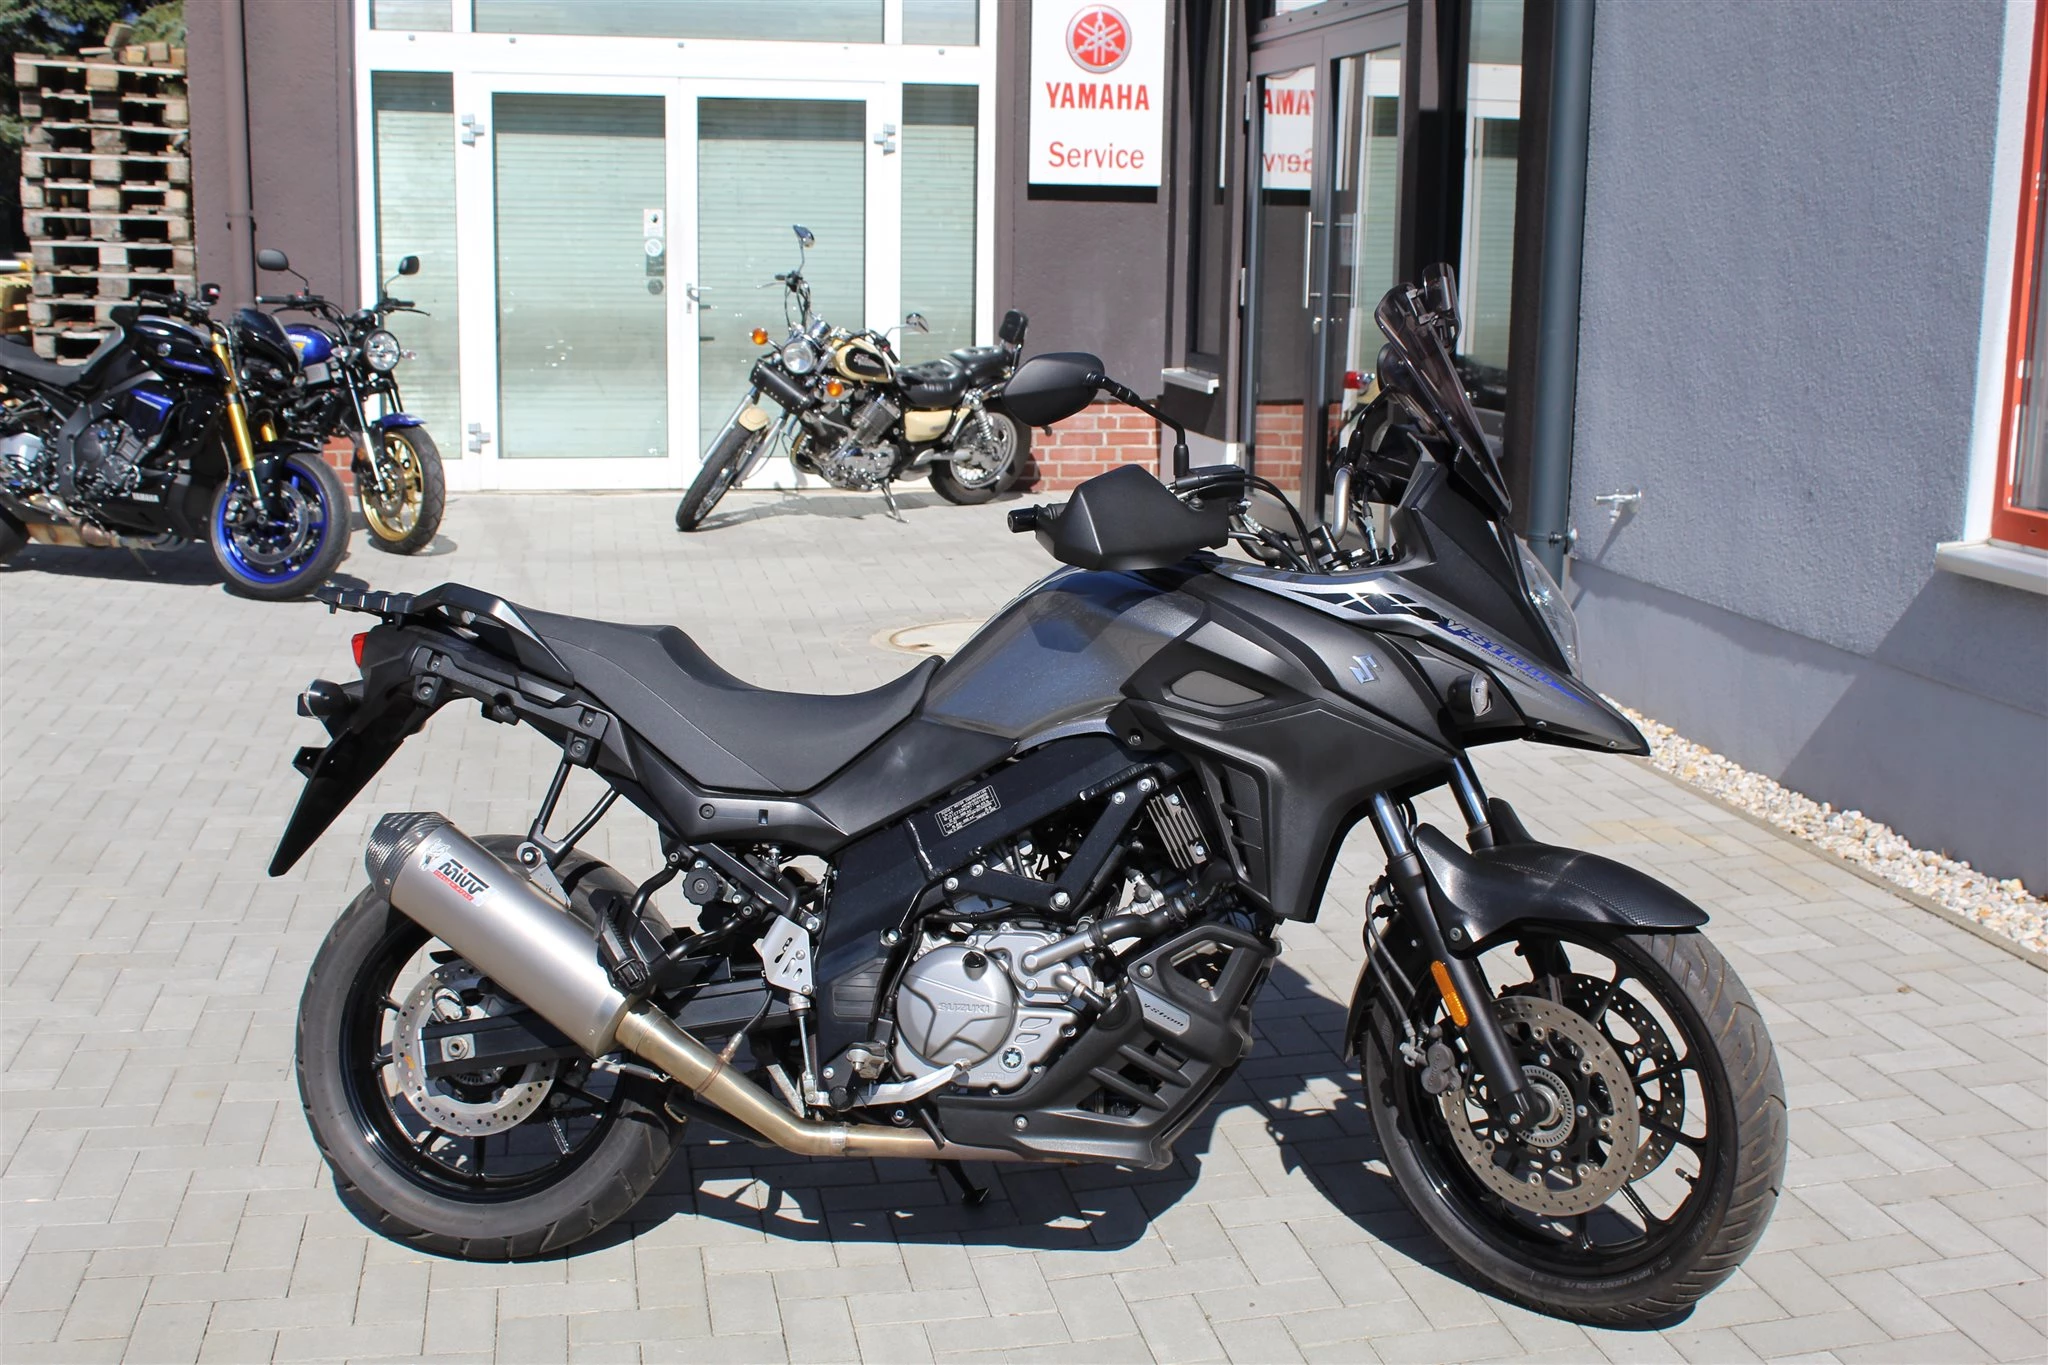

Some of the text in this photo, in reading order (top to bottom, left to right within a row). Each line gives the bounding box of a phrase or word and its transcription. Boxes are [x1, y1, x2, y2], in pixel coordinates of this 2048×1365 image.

[1046, 82, 1149, 110] YAMAHA
[1049, 141, 1145, 169] Service
[938, 1002, 990, 1013] SUZUKI
